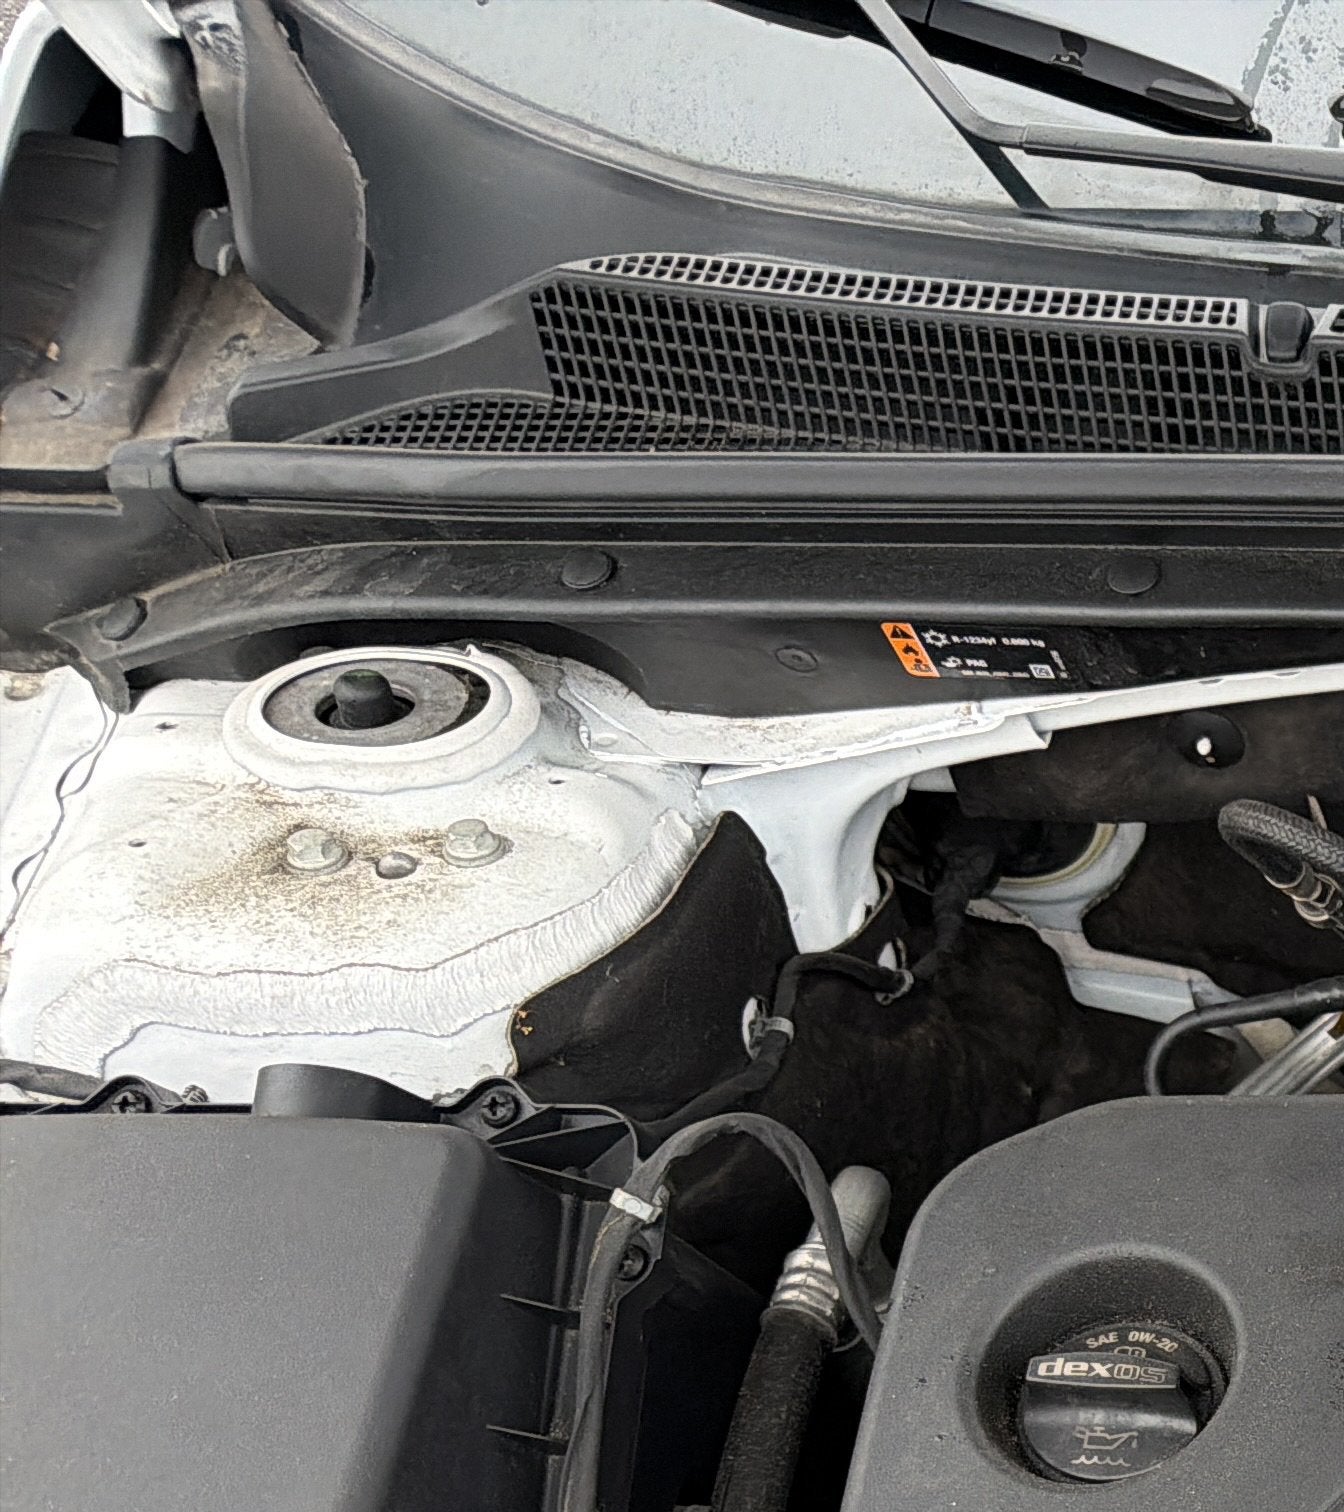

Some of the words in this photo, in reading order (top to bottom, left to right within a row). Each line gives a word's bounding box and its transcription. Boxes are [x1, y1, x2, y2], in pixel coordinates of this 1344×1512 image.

[1086, 1331, 1119, 1349] SAE
[1128, 1331, 1179, 1352] 0W-20
[1037, 1358, 1169, 1383] dexos
